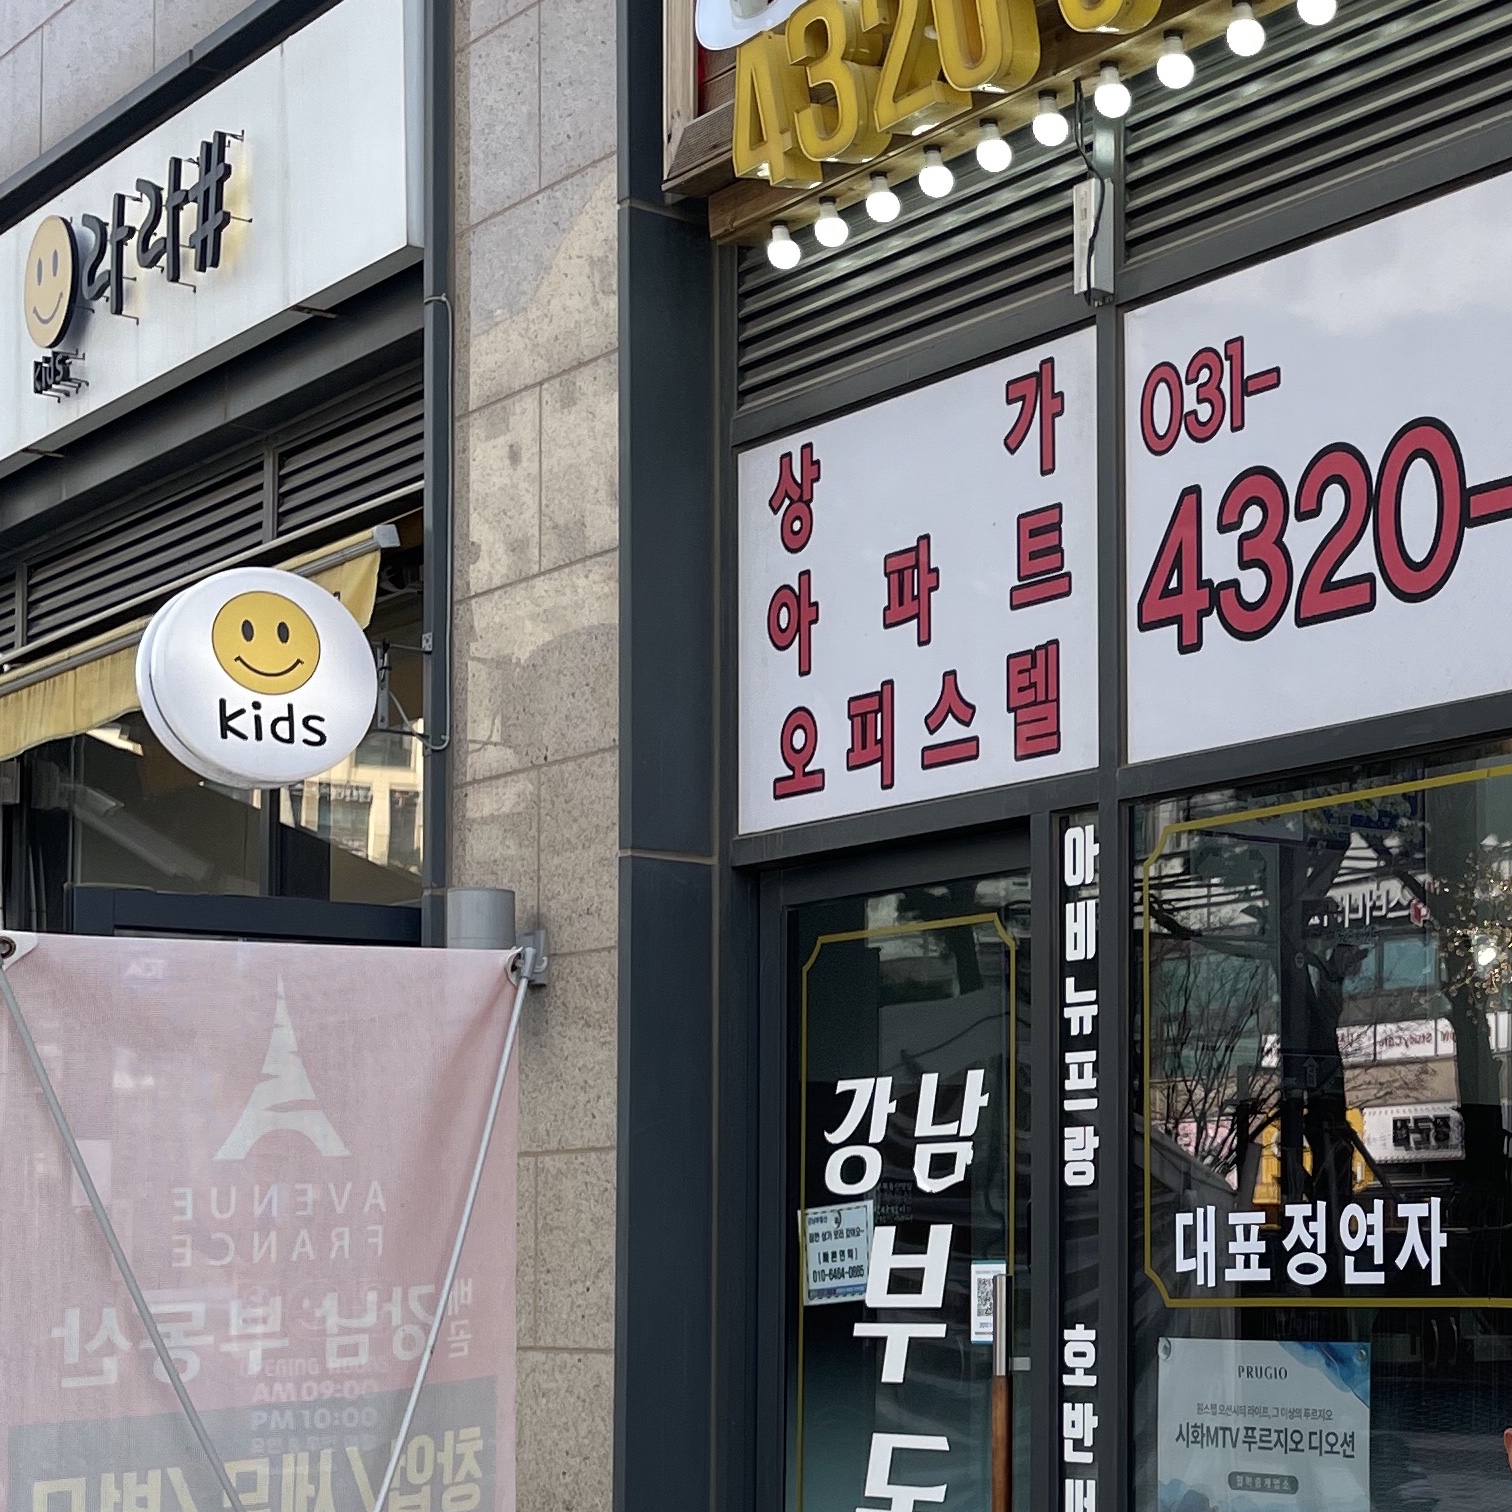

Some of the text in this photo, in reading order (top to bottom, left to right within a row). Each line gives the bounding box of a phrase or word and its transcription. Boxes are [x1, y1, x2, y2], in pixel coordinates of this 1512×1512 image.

[1140, 335, 1281, 457] 031-
[218, 698, 328, 747] kids
[772, 638, 1061, 800] 오피스텔
[1063, 823, 1099, 1187] 아비뉴프랑
[823, 1068, 990, 1196] 강남
[1237, 1364, 1288, 1380] PRUGIO
[1175, 1421, 1356, 1459] 시화MTV 푸르지오 디오션
